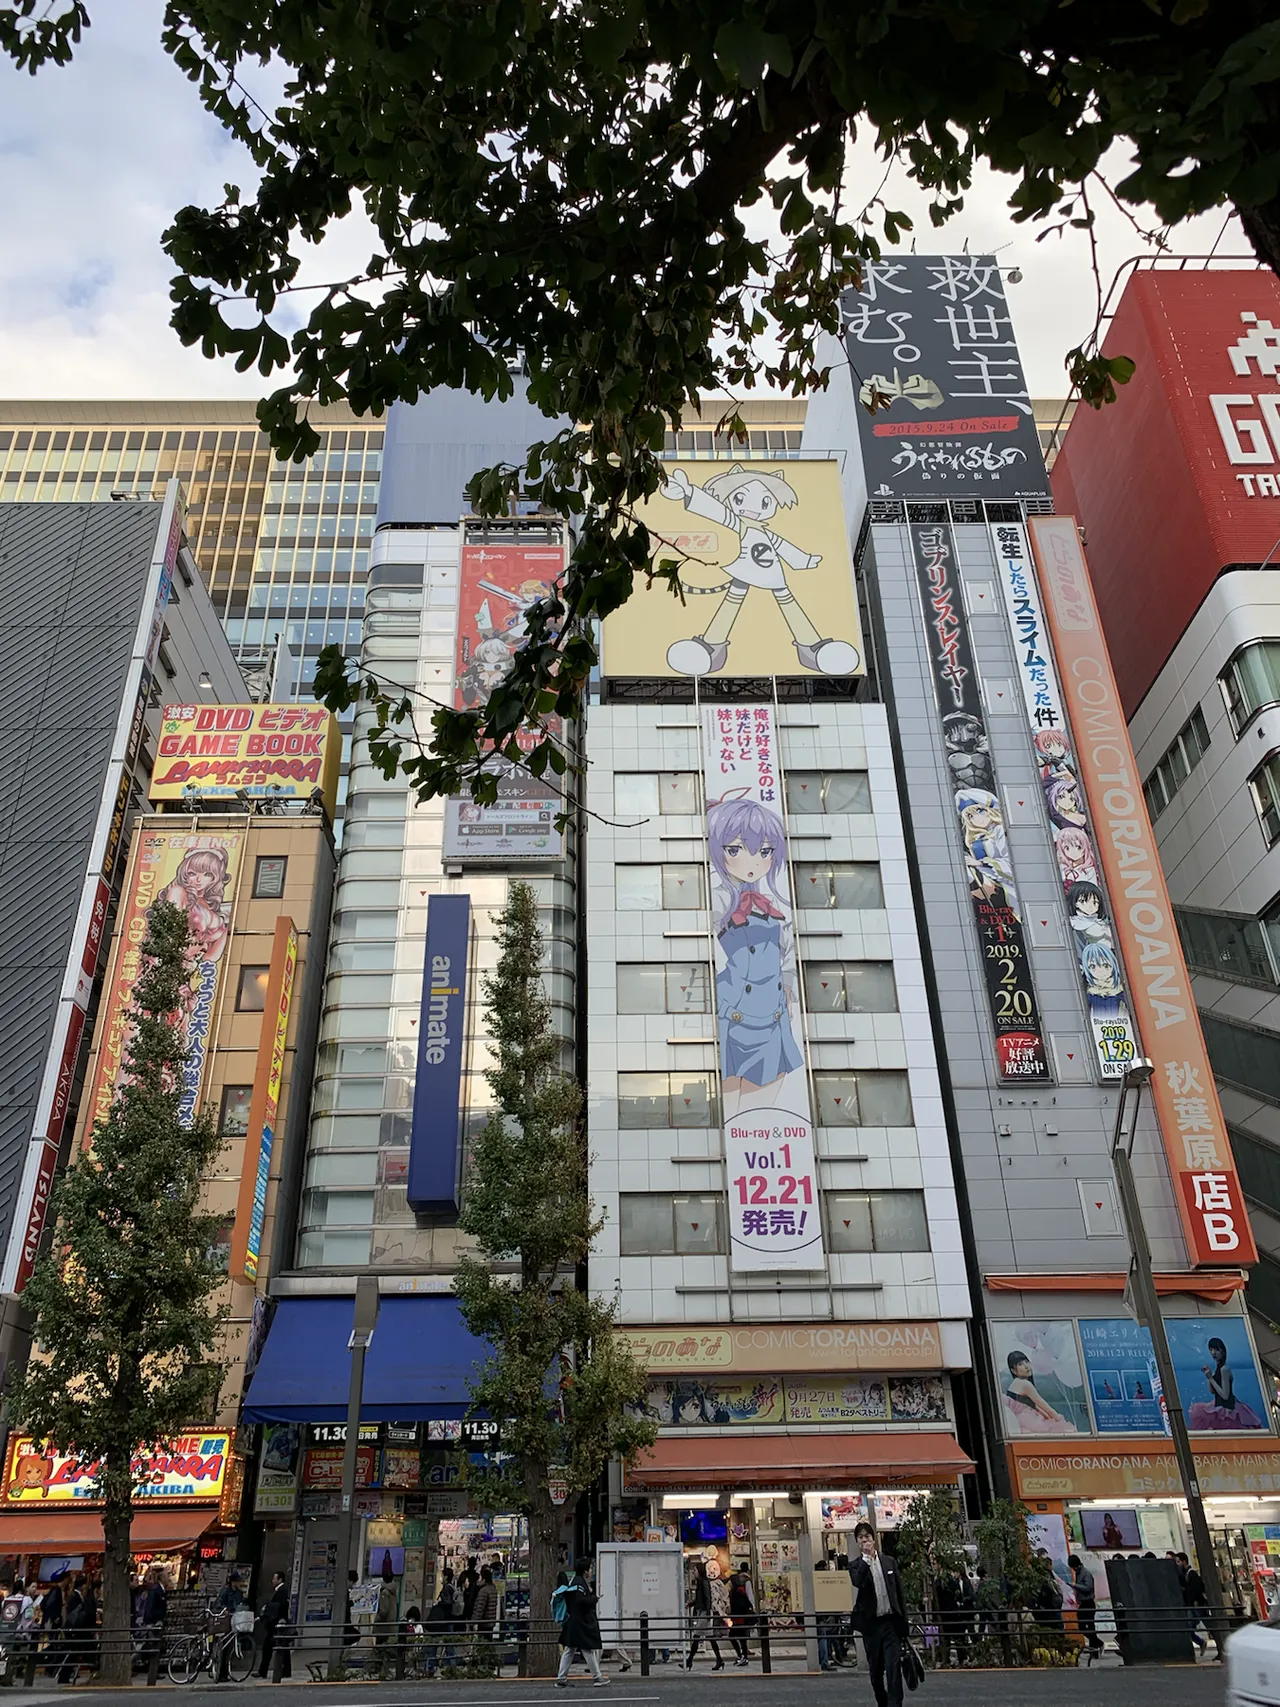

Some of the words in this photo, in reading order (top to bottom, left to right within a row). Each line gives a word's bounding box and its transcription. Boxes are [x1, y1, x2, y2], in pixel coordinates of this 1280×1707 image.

[833, 257, 921, 363] 求む。
[926, 256, 1034, 416] 救世主、
[889, 422, 954, 435] 2015.9.24
[960, 422, 976, 431] On
[982, 420, 1008, 431] Sale
[891, 441, 1028, 478] うたわれるもの
[919, 527, 968, 708] ゴブリンスレイヤー
[996, 526, 1059, 727] 転生したらスライムだった件
[194, 708, 254, 732] DVD
[258, 708, 329, 731] ビデオ
[717, 708, 735, 774] 妹じゃない
[735, 708, 753, 760] 妹だけど
[159, 734, 242, 757] GAME
[246, 734, 326, 757] BOOK
[753, 708, 775, 801] 俺が好きなのは
[215, 774, 267, 785] ラムタラ
[1071, 655, 1188, 1030] COMICTORANOANA
[134, 871, 156, 908] DVD
[979, 904, 1014, 916] Blu-ray
[990, 914, 1016, 925] DVD
[127, 917, 146, 943] CD
[986, 944, 1023, 959] 2019.
[425, 954, 460, 1066] animate
[994, 990, 1033, 1017] 20
[997, 1016, 1011, 1025] ON
[1012, 1016, 1035, 1025] SALE
[1000, 1037, 1040, 1047] TVアニメ
[1101, 1026, 1126, 1040] 2019
[1009, 1048, 1036, 1060] 好評
[1099, 1041, 1135, 1063] 1.29
[1005, 1060, 1044, 1075] 放送中
[1103, 1063, 1116, 1075] ON
[52, 1063, 70, 1121] AKIBA
[731, 1127, 771, 1139] Blu-ray
[772, 1127, 782, 1138] &
[784, 1127, 807, 1138] DVD
[744, 1144, 791, 1170] Vol.1
[734, 1175, 813, 1205] 12.21
[24, 1169, 49, 1263] ISLAND
[742, 1209, 808, 1236] 発売!
[398, 1277, 447, 1291] animate
[735, 1327, 936, 1349] COMICTORANOANA
[810, 1346, 937, 1358] www.toranoana.co.jp/
[1128, 1349, 1155, 1357] RELEA
[787, 1389, 835, 1406] 9月27日
[790, 1406, 812, 1419] 発売
[464, 1422, 499, 1435] 11.30
[1018, 1456, 1152, 1471] COMICTORANOANA
[1155, 1455, 1229, 1469] AKIBARA
[1232, 1454, 1269, 1468] MAIN
[137, 1484, 195, 1495] AKIBA
